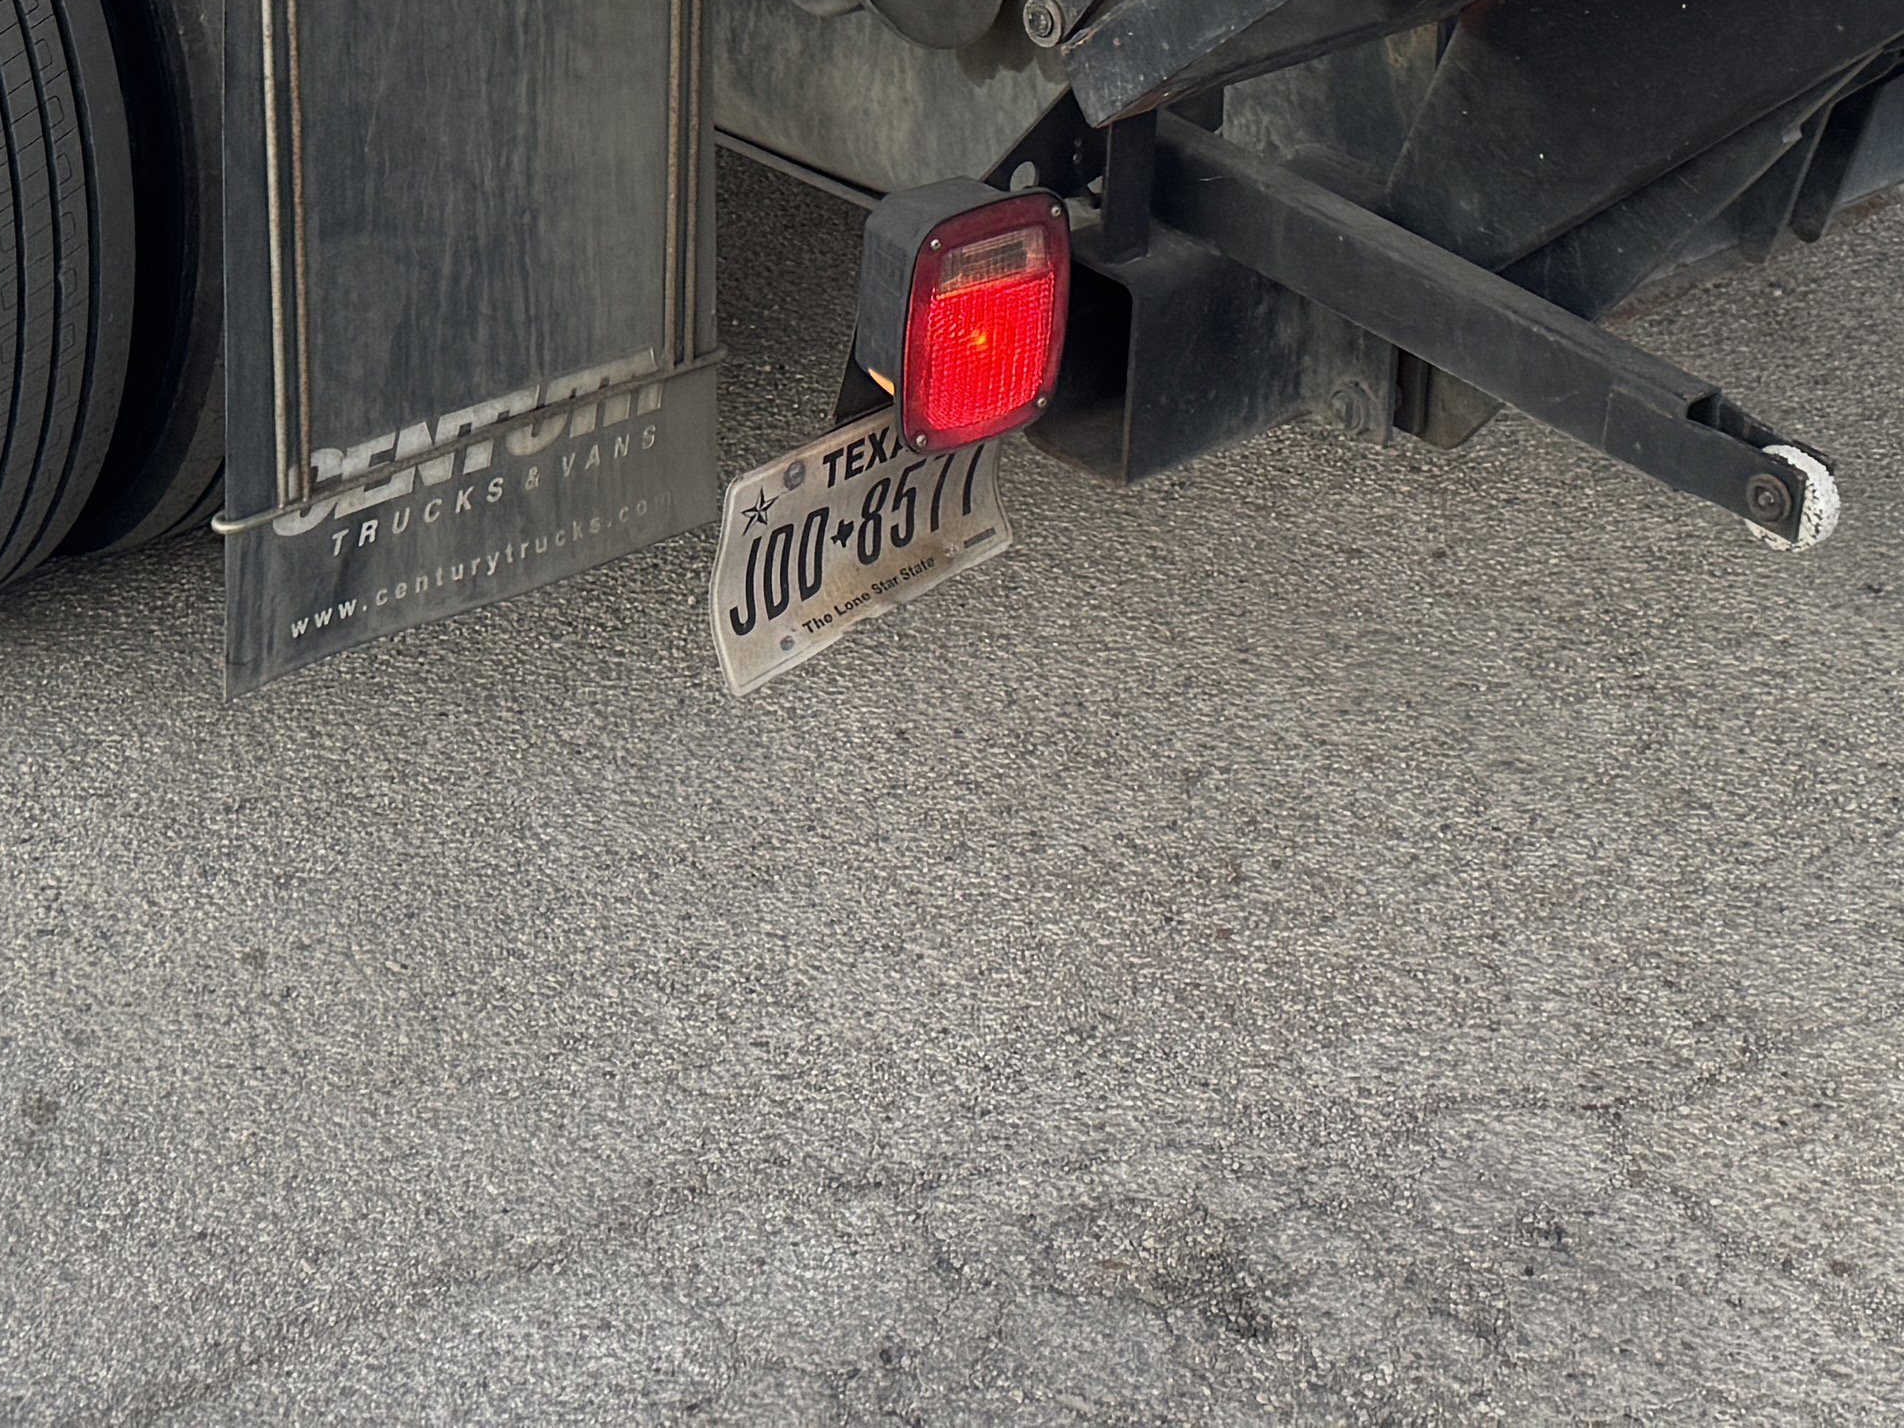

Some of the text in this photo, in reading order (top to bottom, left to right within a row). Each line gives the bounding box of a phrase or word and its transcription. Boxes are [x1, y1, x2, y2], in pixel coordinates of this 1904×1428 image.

[330, 424, 657, 558] TRUCKS & VANS
[823, 425, 904, 488] TEX
[290, 490, 672, 639] www.centurytrucks.com
[801, 556, 936, 634] The Lone Star State
